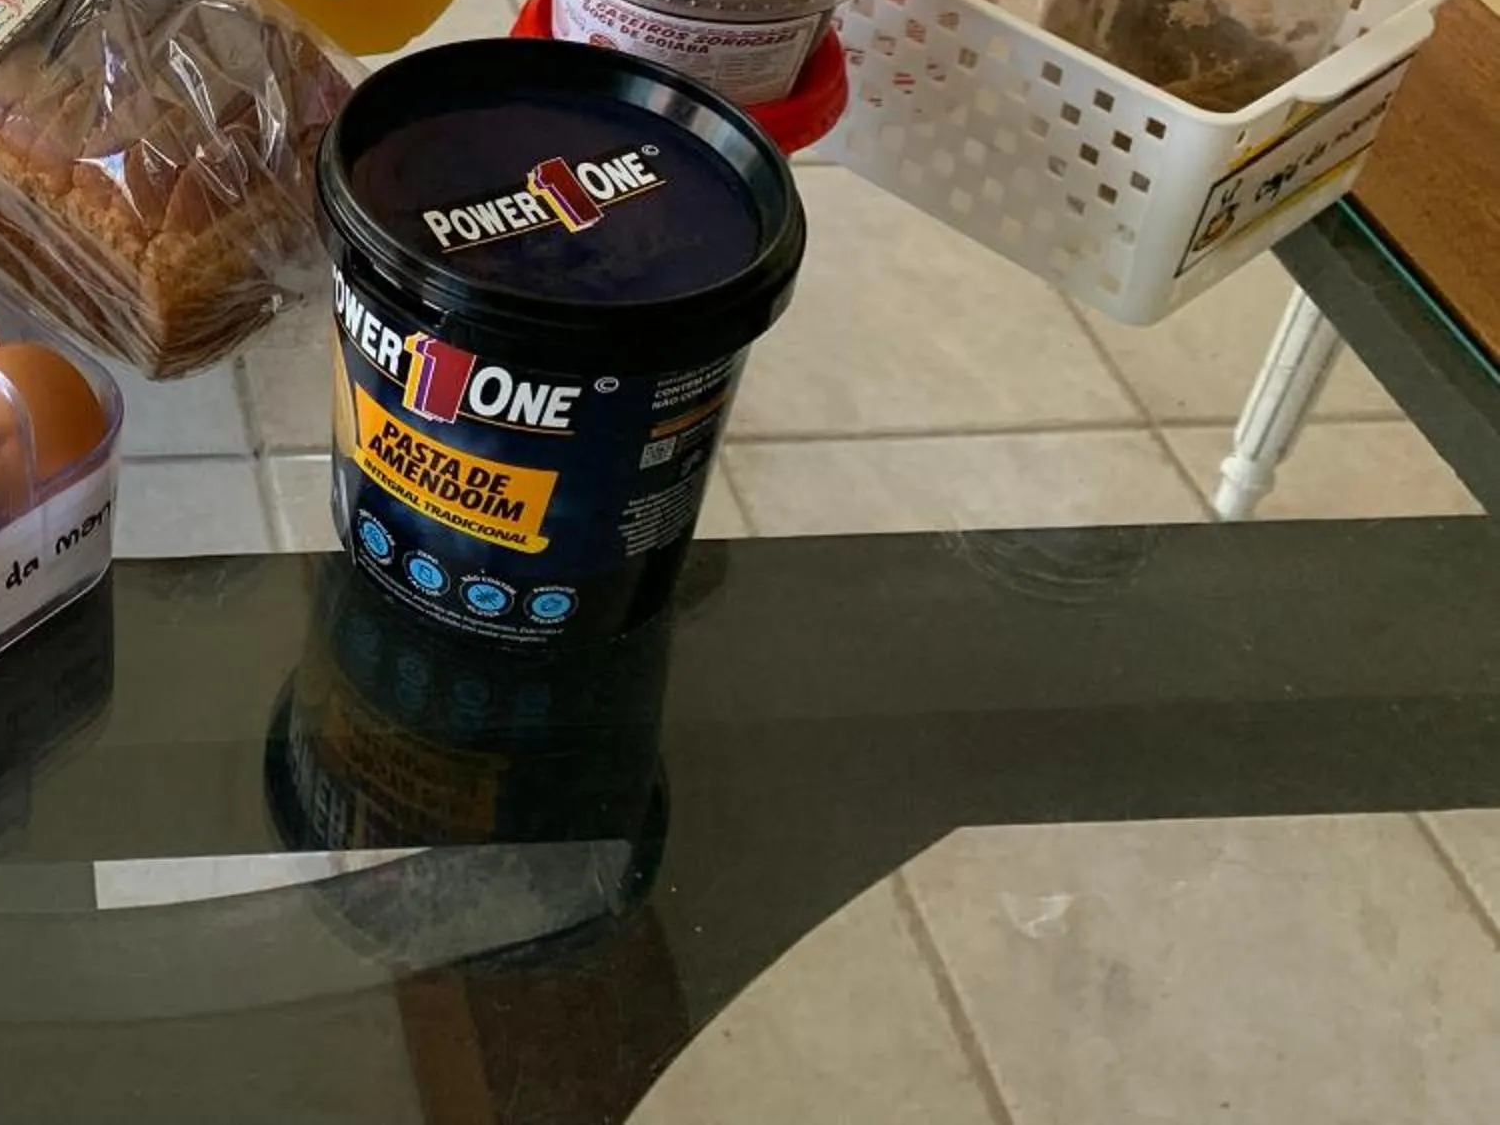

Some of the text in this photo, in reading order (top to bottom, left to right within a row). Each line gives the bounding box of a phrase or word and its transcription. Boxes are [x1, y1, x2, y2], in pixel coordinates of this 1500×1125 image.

[596, 2, 690, 41] CASEIROS
[619, 25, 640, 40] DE
[643, 32, 709, 55] GOIABA
[368, 434, 525, 522] AMENDOIM
[382, 421, 511, 495] PASTA DE
[363, 457, 420, 506] INTEGRAL
[424, 501, 528, 546] TRADICIONAL
[6, 557, 39, 589] da
